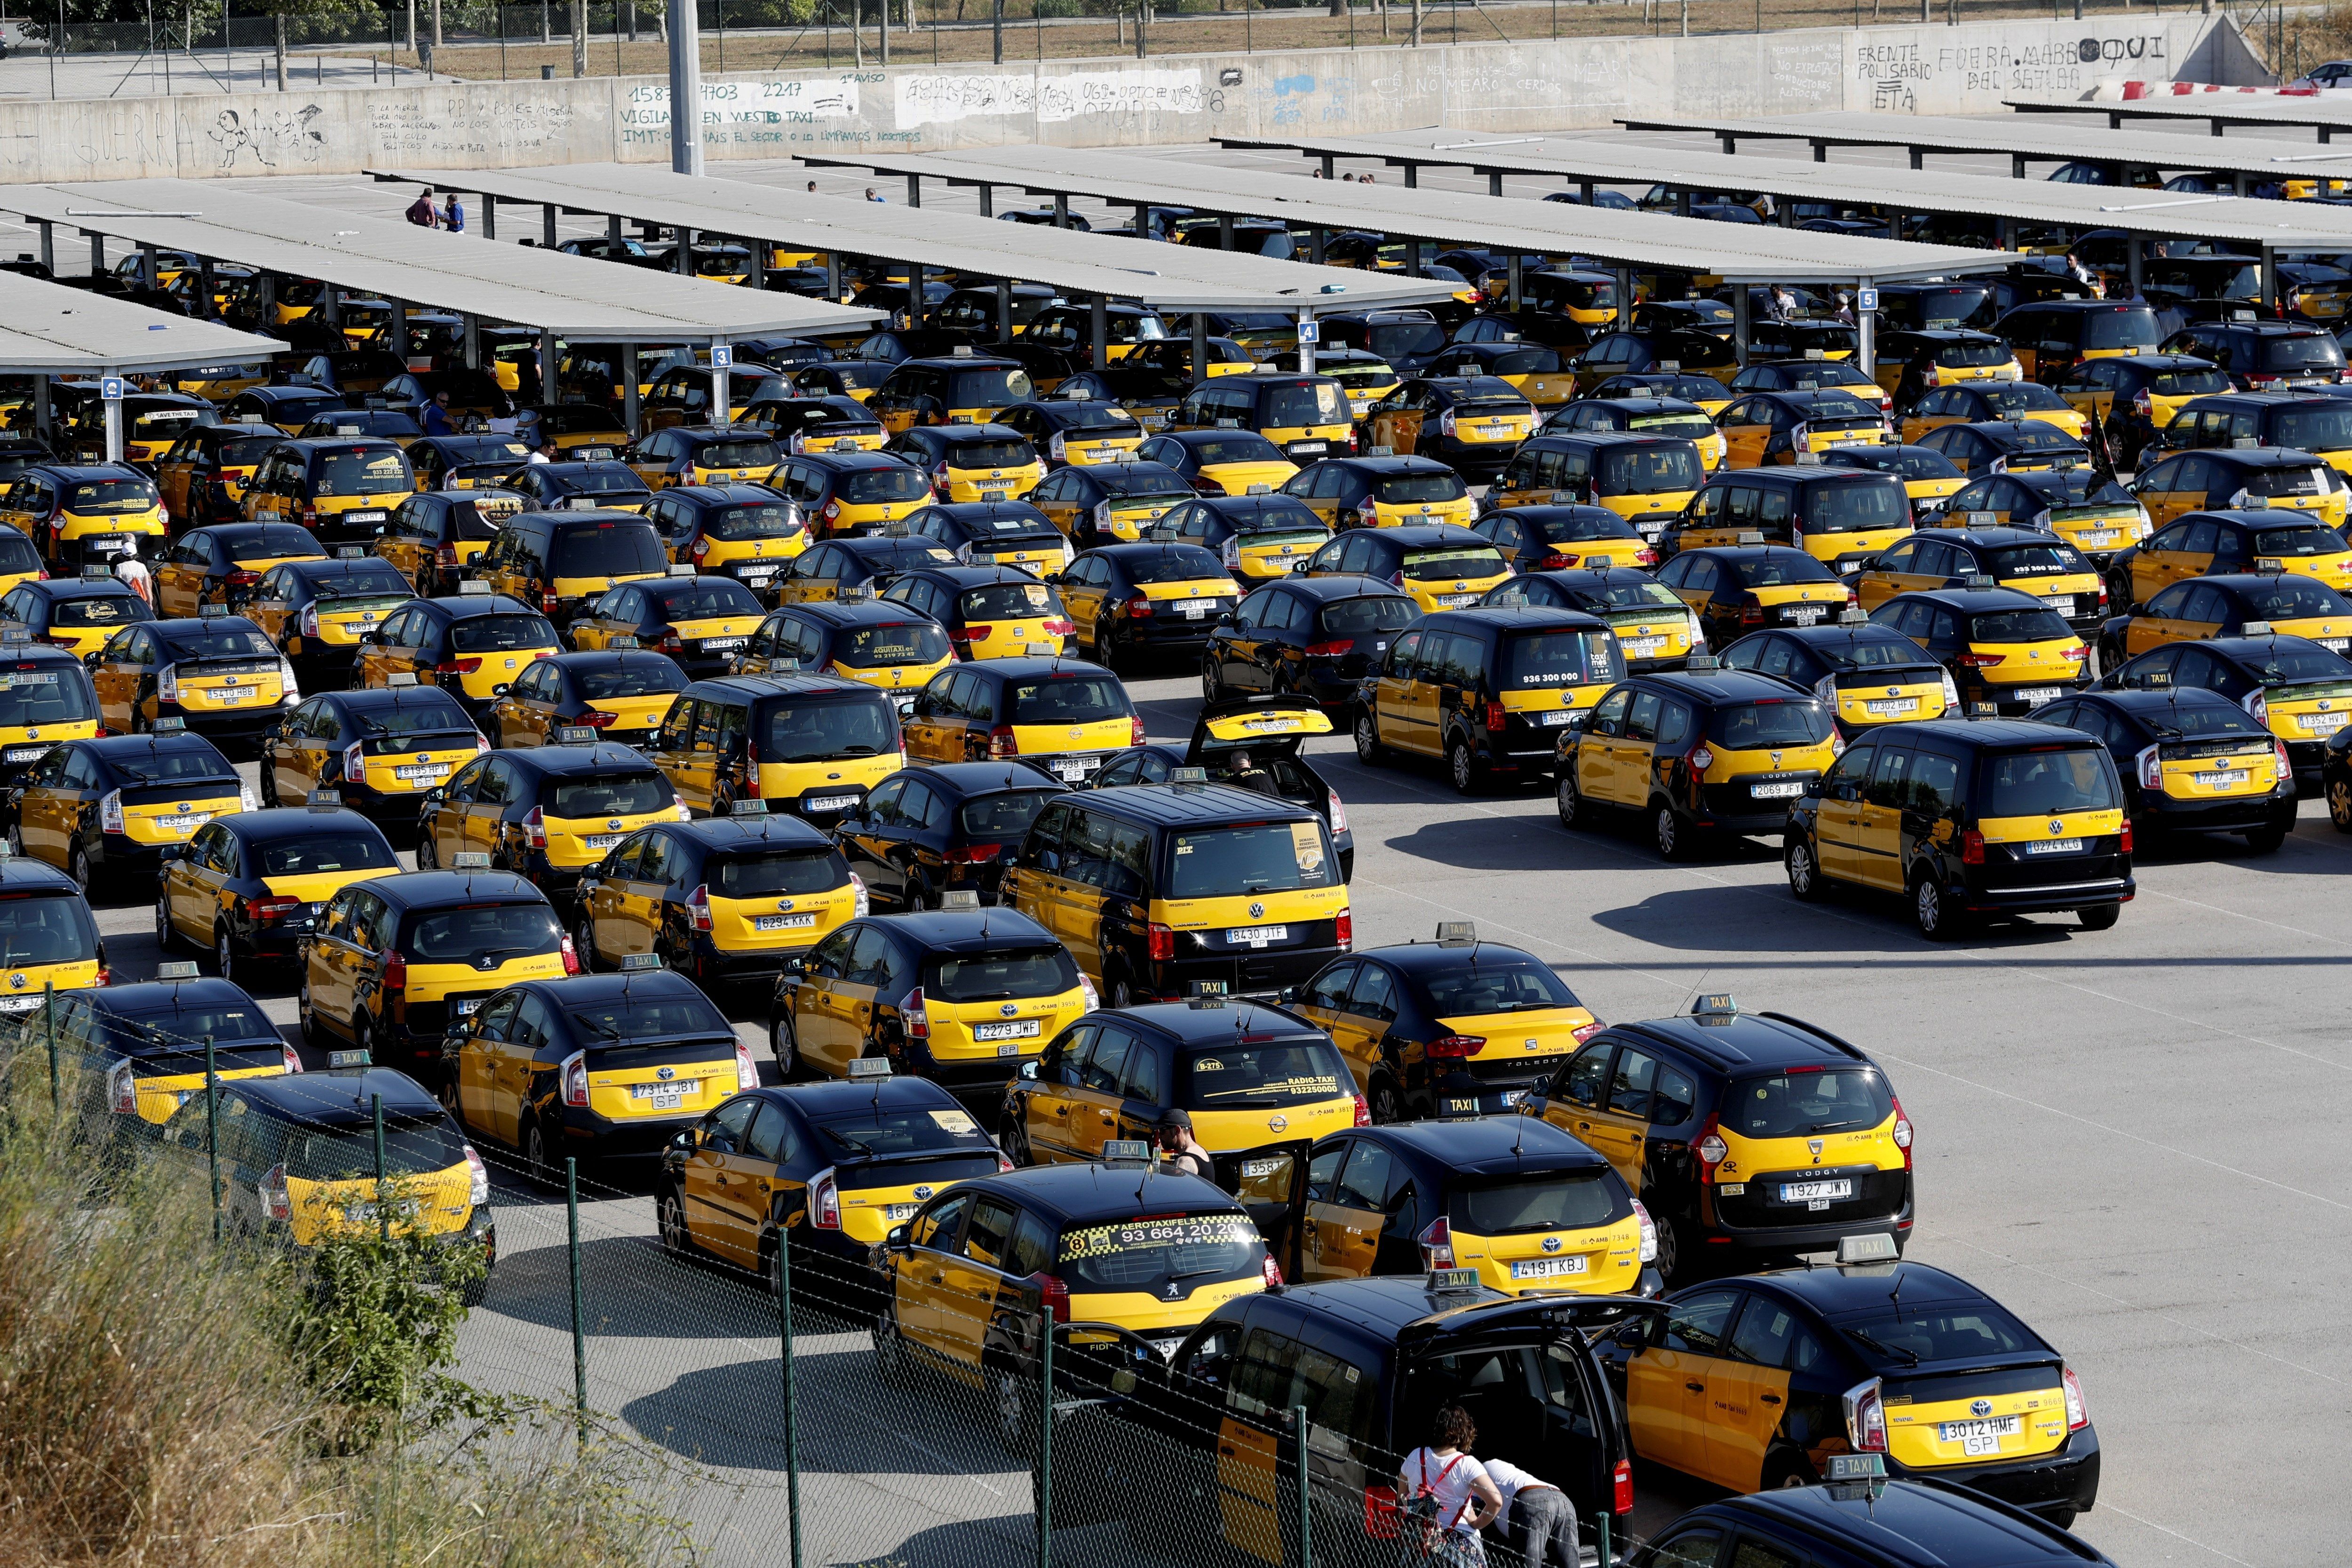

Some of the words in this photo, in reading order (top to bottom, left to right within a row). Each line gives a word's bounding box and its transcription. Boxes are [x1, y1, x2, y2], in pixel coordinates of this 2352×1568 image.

[1859, 45, 1921, 62] FRENTE
[1778, 60, 1791, 71] NO
[1574, 60, 1622, 84] MEAR
[1416, 78, 1438, 92] NO
[1516, 79, 1562, 95] CERDOS
[1774, 72, 1833, 92] CONDUCTORES
[762, 83, 802, 98] 2217
[1779, 88, 1822, 101] AUTOCAR
[1875, 87, 1914, 111] ETA
[735, 133, 747, 142] EL
[877, 131, 921, 143] NOSOTROS
[1864, 294, 1872, 305] 5
[1304, 326, 1312, 338] 4
[717, 351, 726, 362] 3
[475, 499, 523, 512] ELITE
[1523, 674, 1540, 683] 936
[1874, 701, 1895, 709] 7302
[1899, 699, 1914, 708] HFV
[429, 764, 446, 773] HPY
[1081, 758, 1098, 767] HBF
[2202, 772, 2224, 782] 7737
[2229, 770, 2245, 780] JHW
[1758, 786, 1780, 795] 2069
[1784, 784, 1800, 793] JFY
[815, 798, 837, 807] 0576
[190, 812, 207, 823] HCJ
[2034, 841, 2058, 851] 0274
[2061, 840, 2079, 849] KLG
[763, 916, 789, 927] 6294
[792, 913, 811, 925] KKK
[1234, 929, 1260, 939] 8430
[1264, 927, 1282, 937] JTF
[1200, 982, 1220, 994] TAXI
[1710, 996, 1728, 1008] TAXI
[983, 1026, 1011, 1036] 2279
[1016, 1022, 1036, 1032] JWF
[341, 1053, 360, 1063] TAXI
[1288, 1076, 1335, 1085] RADIO-TAXI
[639, 1083, 669, 1096] 7314
[675, 1080, 695, 1091] JBY
[1290, 1085, 1337, 1094] 932250000
[1450, 1099, 1471, 1112] TAXI
[1119, 1144, 1138, 1155] TAXI
[1791, 1184, 1820, 1196] 1927
[1827, 1181, 1850, 1193] JWY
[1811, 1200, 1827, 1209] SP
[1120, 1217, 1197, 1231] AEROTAXIFELS
[1121, 1231, 1145, 1242] 93
[1151, 1226, 1184, 1239] 664
[1190, 1225, 1211, 1237] 20
[1217, 1223, 1237, 1235] 20
[1072, 1238, 1081, 1250] 8
[1859, 1241, 1884, 1255] TAXI
[1521, 1261, 1554, 1275] 4191
[1559, 1256, 1584, 1270] KBJ
[1448, 1273, 1469, 1284] TAXI
[1951, 1422, 1984, 1439] 3012
[1990, 1417, 2015, 1433] HMF
[1969, 1438, 1994, 1453] SP
[1847, 1459, 1872, 1473] TAXI
